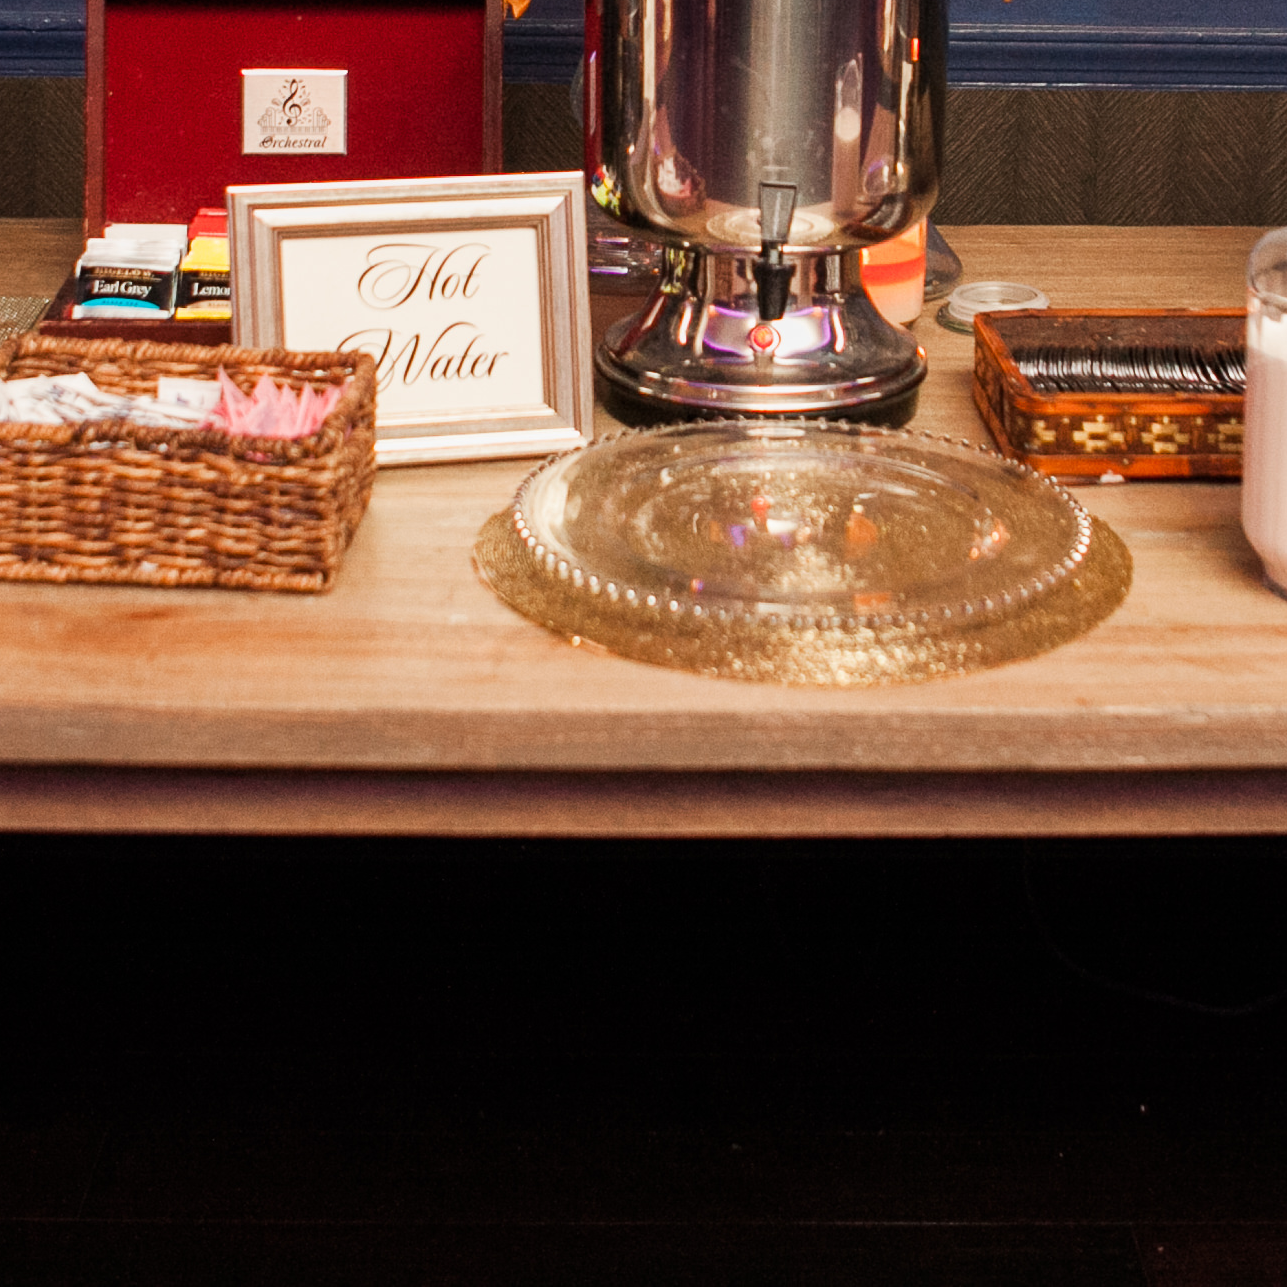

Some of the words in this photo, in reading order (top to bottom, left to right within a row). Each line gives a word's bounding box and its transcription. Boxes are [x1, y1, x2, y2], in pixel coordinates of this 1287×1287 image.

[259, 134, 327, 149] Orchestral
[93, 279, 119, 294] Earl
[120, 281, 152, 298] Grey
[358, 243, 492, 310] Hot
[337, 321, 509, 393] Water
